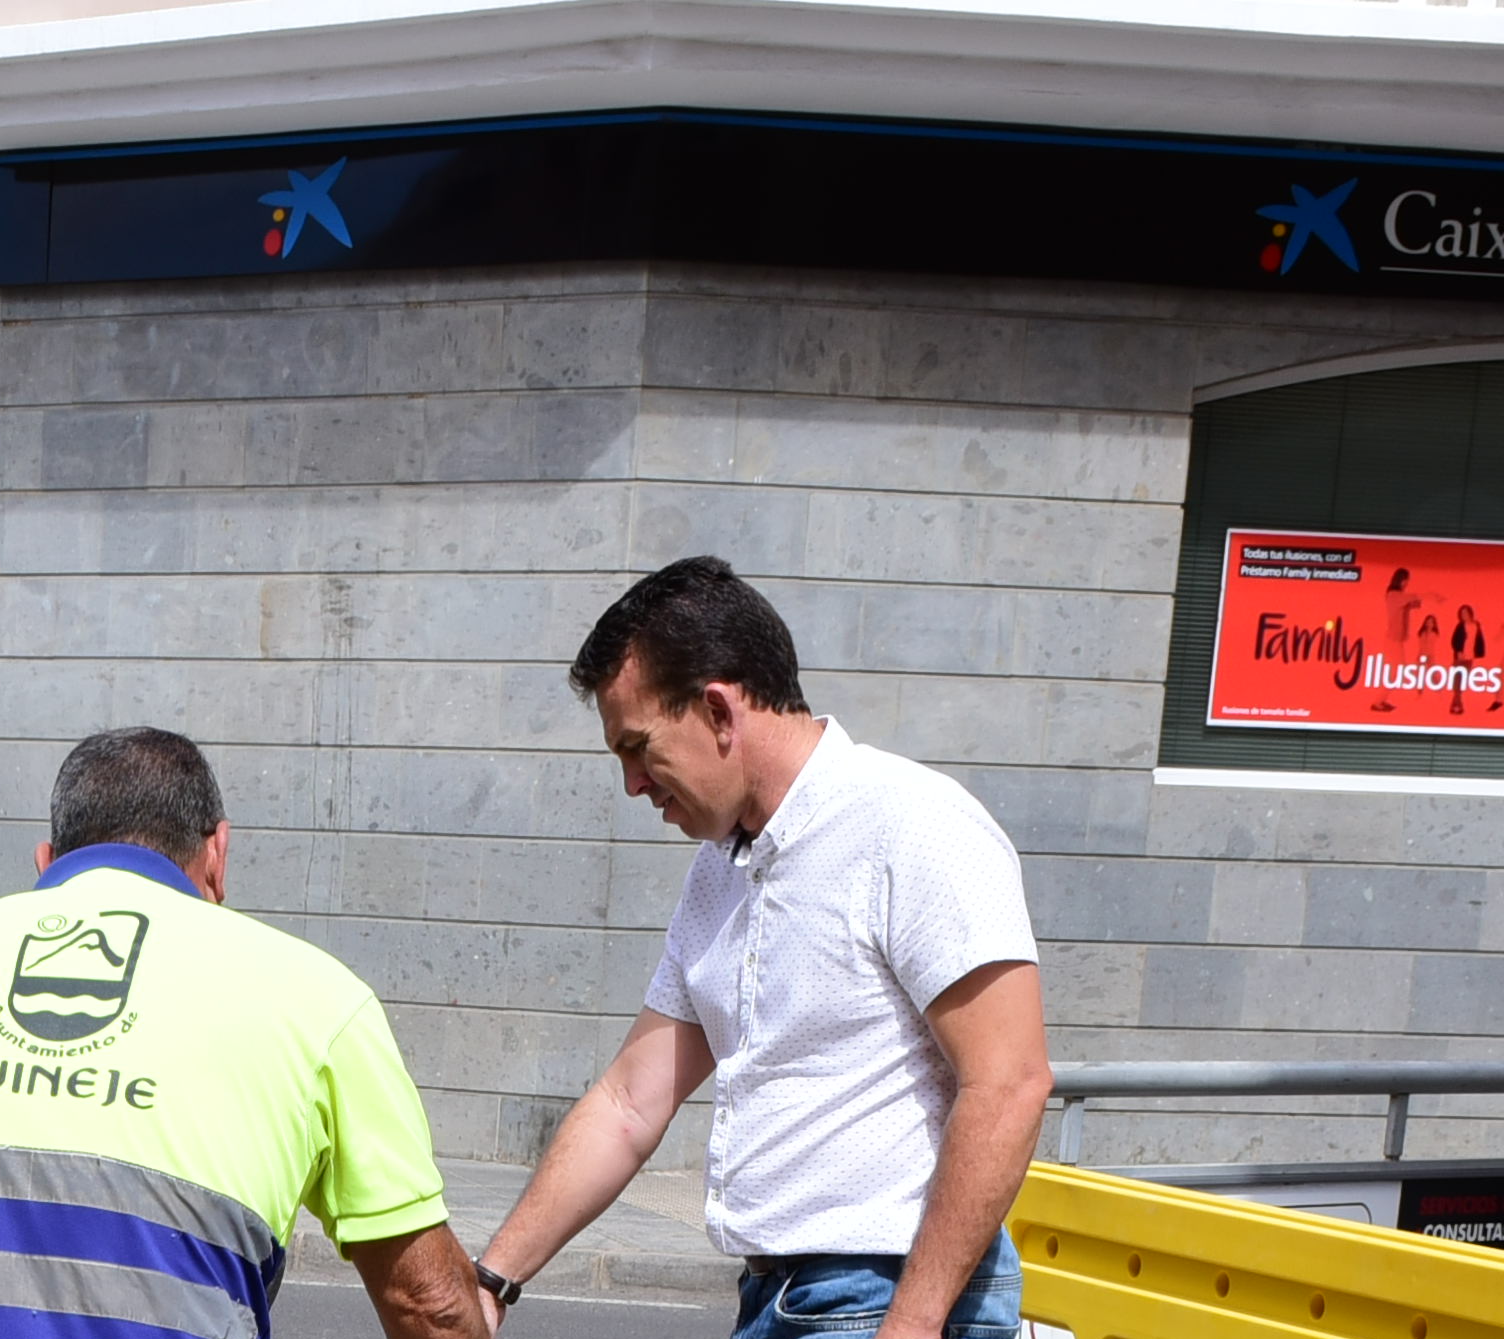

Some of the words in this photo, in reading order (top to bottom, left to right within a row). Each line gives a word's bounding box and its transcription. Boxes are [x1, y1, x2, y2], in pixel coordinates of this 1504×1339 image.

[1254, 612, 1364, 690] Family
[1364, 652, 1502, 693] Ilusiones
[121, 1011, 138, 1034] de
